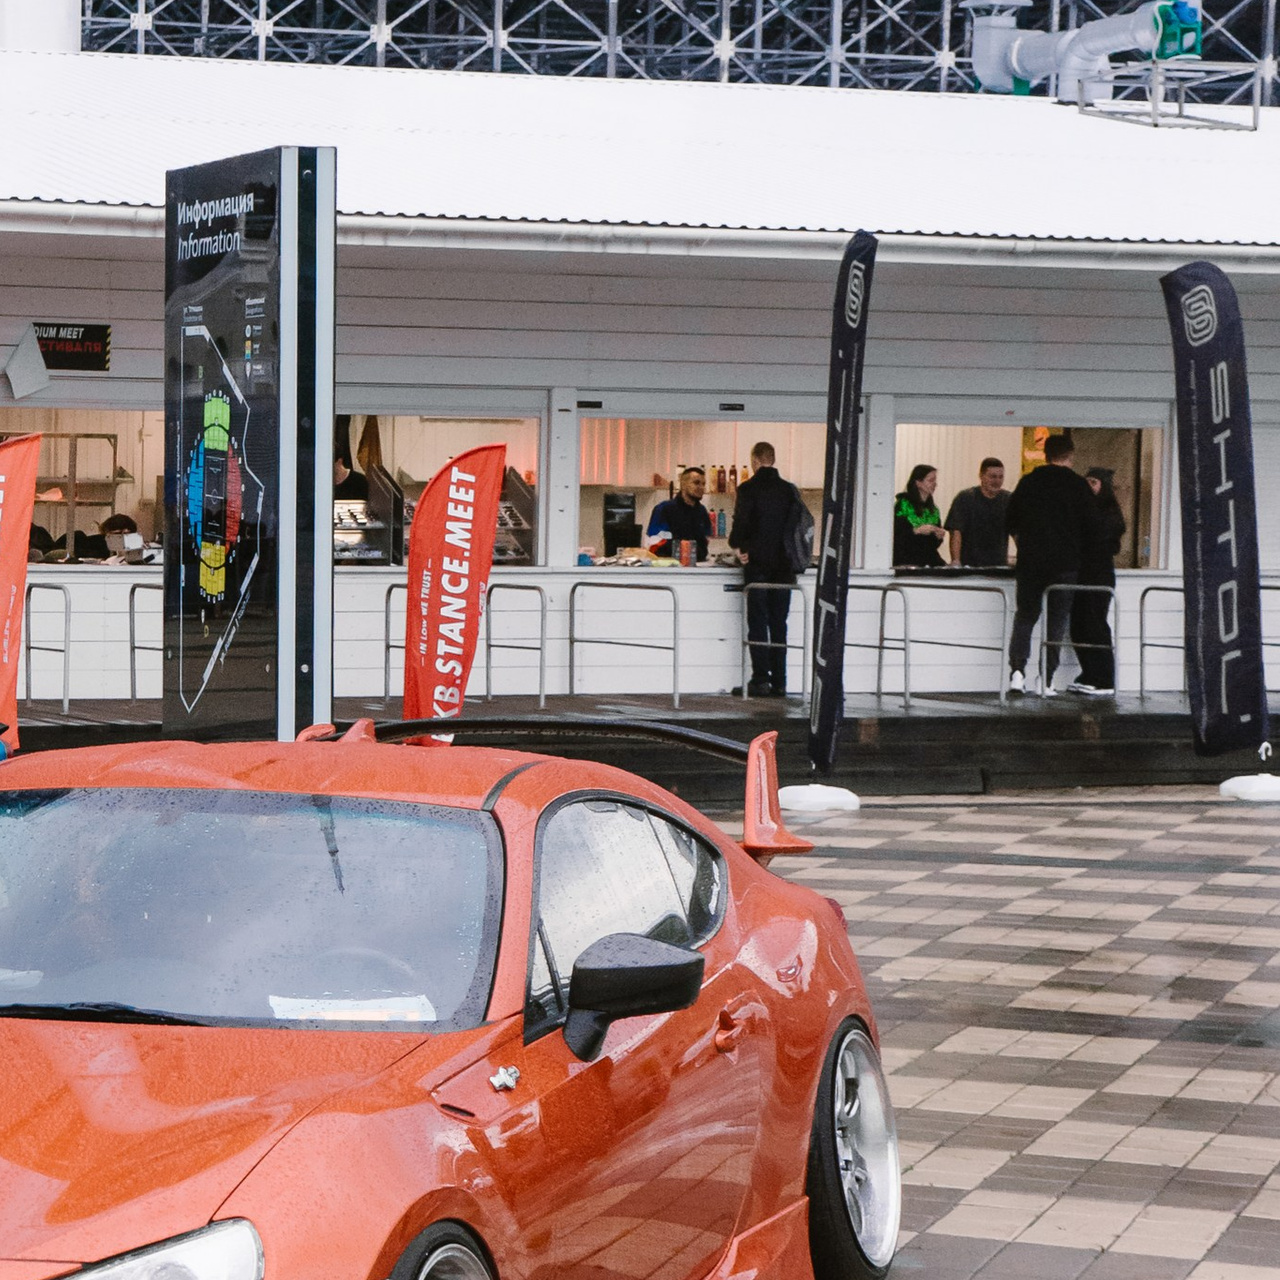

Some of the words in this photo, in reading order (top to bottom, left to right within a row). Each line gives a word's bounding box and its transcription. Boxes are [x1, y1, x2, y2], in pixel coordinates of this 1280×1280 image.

[177, 192, 254, 229] Информация
[177, 229, 241, 261] Information
[58, 327, 85, 339] MEET
[421, 569, 432, 599] TRUST
[420, 601, 429, 616] WE
[419, 643, 427, 654] IN
